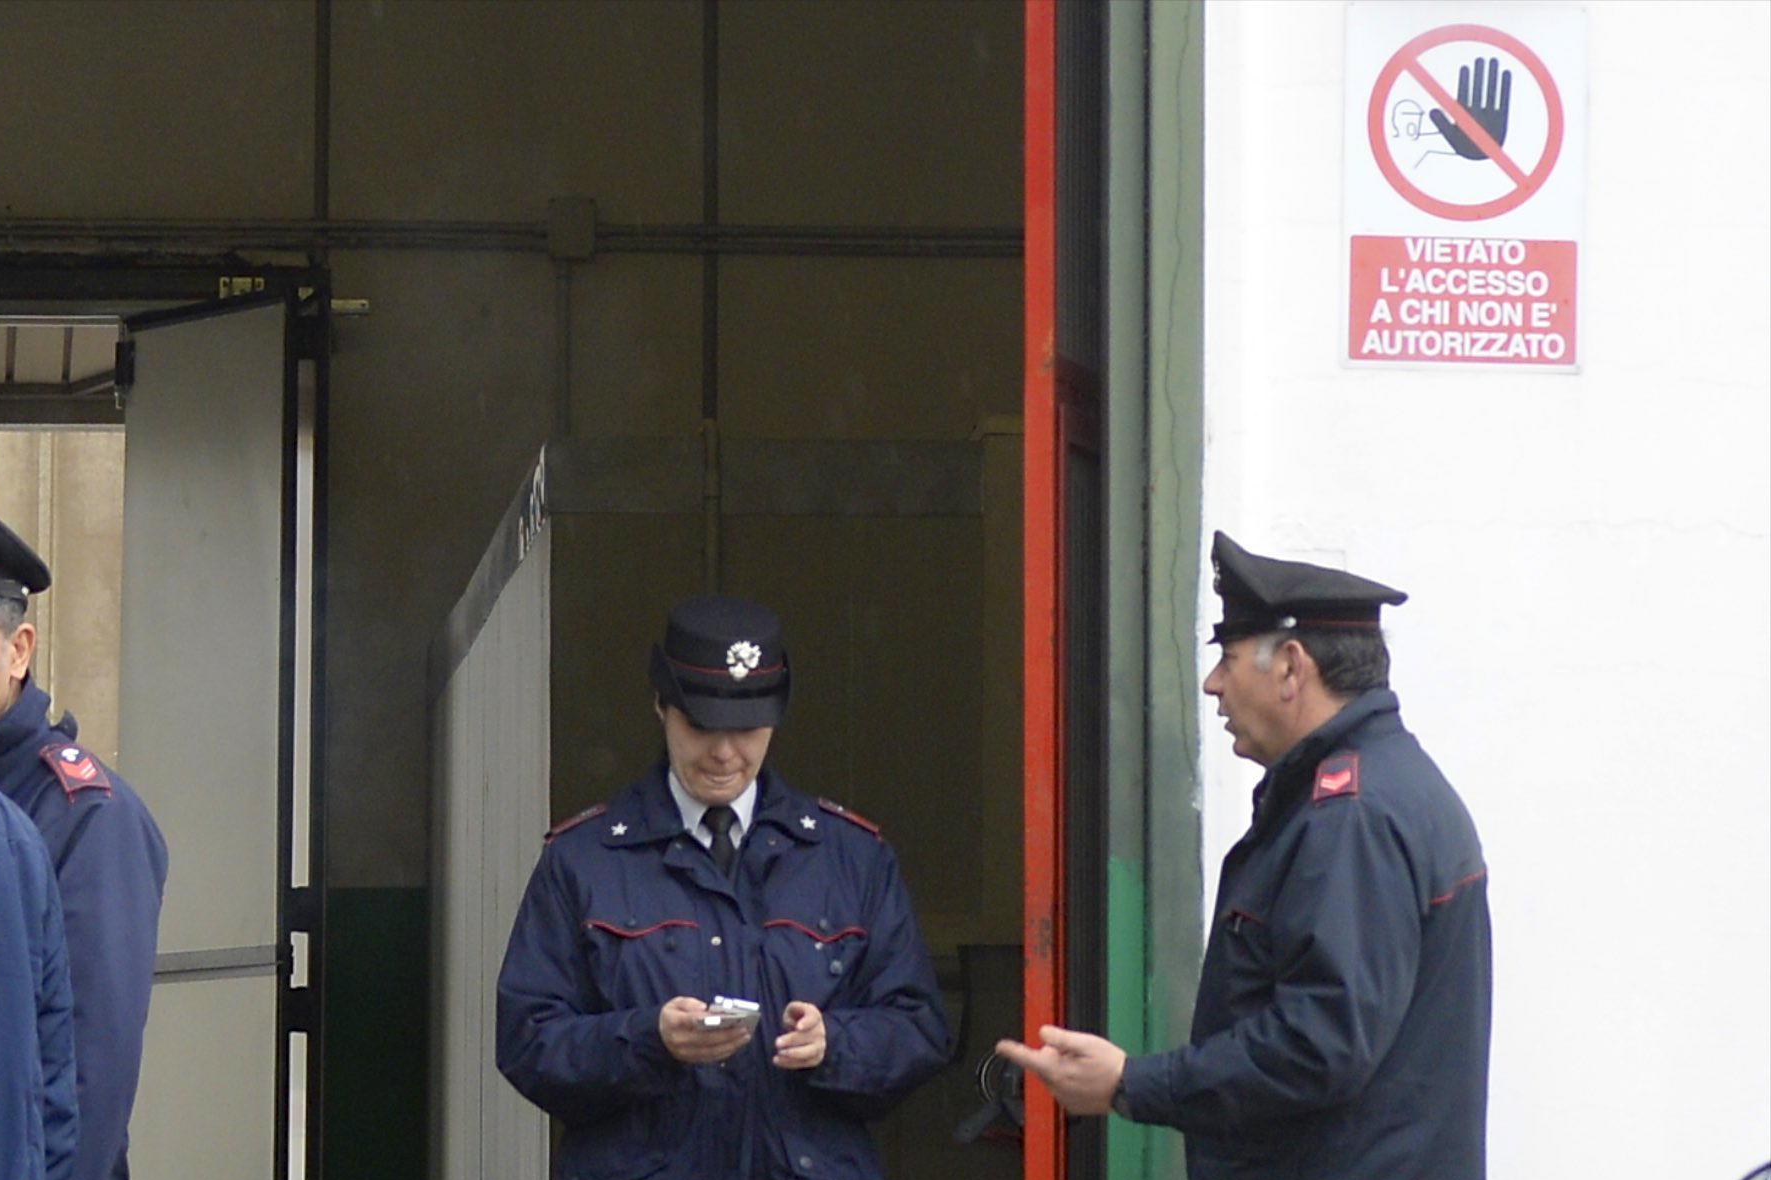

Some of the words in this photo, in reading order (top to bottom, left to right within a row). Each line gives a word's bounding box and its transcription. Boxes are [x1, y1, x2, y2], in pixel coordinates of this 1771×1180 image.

[1405, 238, 1526, 264] VIETATO
[1381, 269, 1549, 297] L'ACCESSO
[1371, 299, 1393, 324] A
[1400, 301, 1450, 326] CHI
[1459, 302, 1523, 327] NON
[1531, 303, 1558, 328] E'
[1361, 331, 1566, 359] AUTORIZZATO
